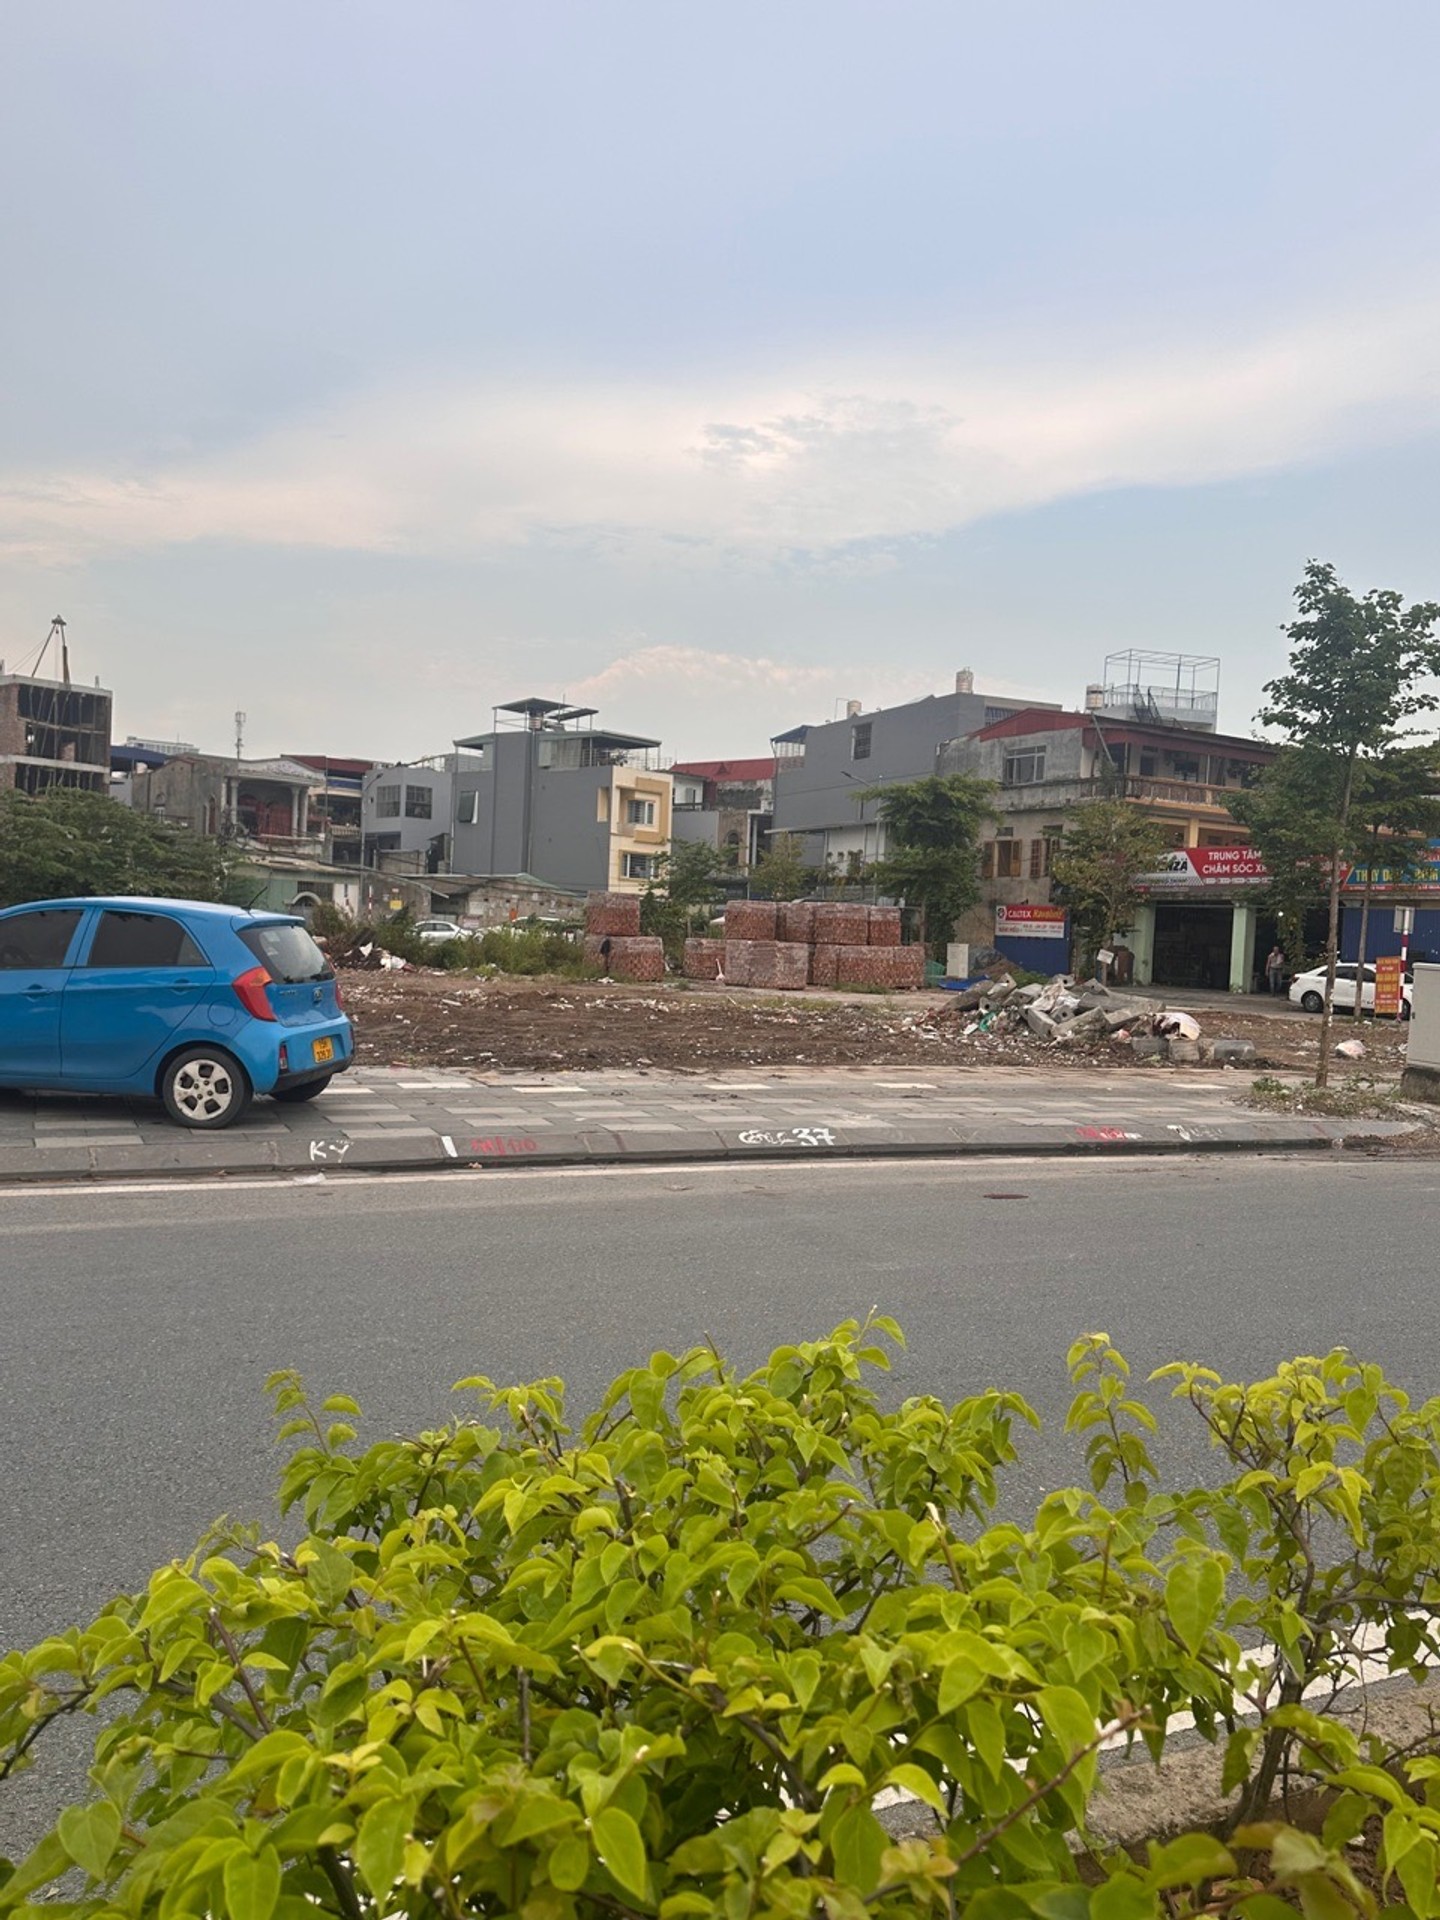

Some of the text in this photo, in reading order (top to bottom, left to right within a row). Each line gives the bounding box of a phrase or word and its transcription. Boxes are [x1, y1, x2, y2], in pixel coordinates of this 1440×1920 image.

[1208, 851, 1239, 861] TRUNG
[1232, 862, 1254, 873] SÓC
[1008, 910, 1032, 919] CALTEX
[791, 1127, 836, 1146] 37
